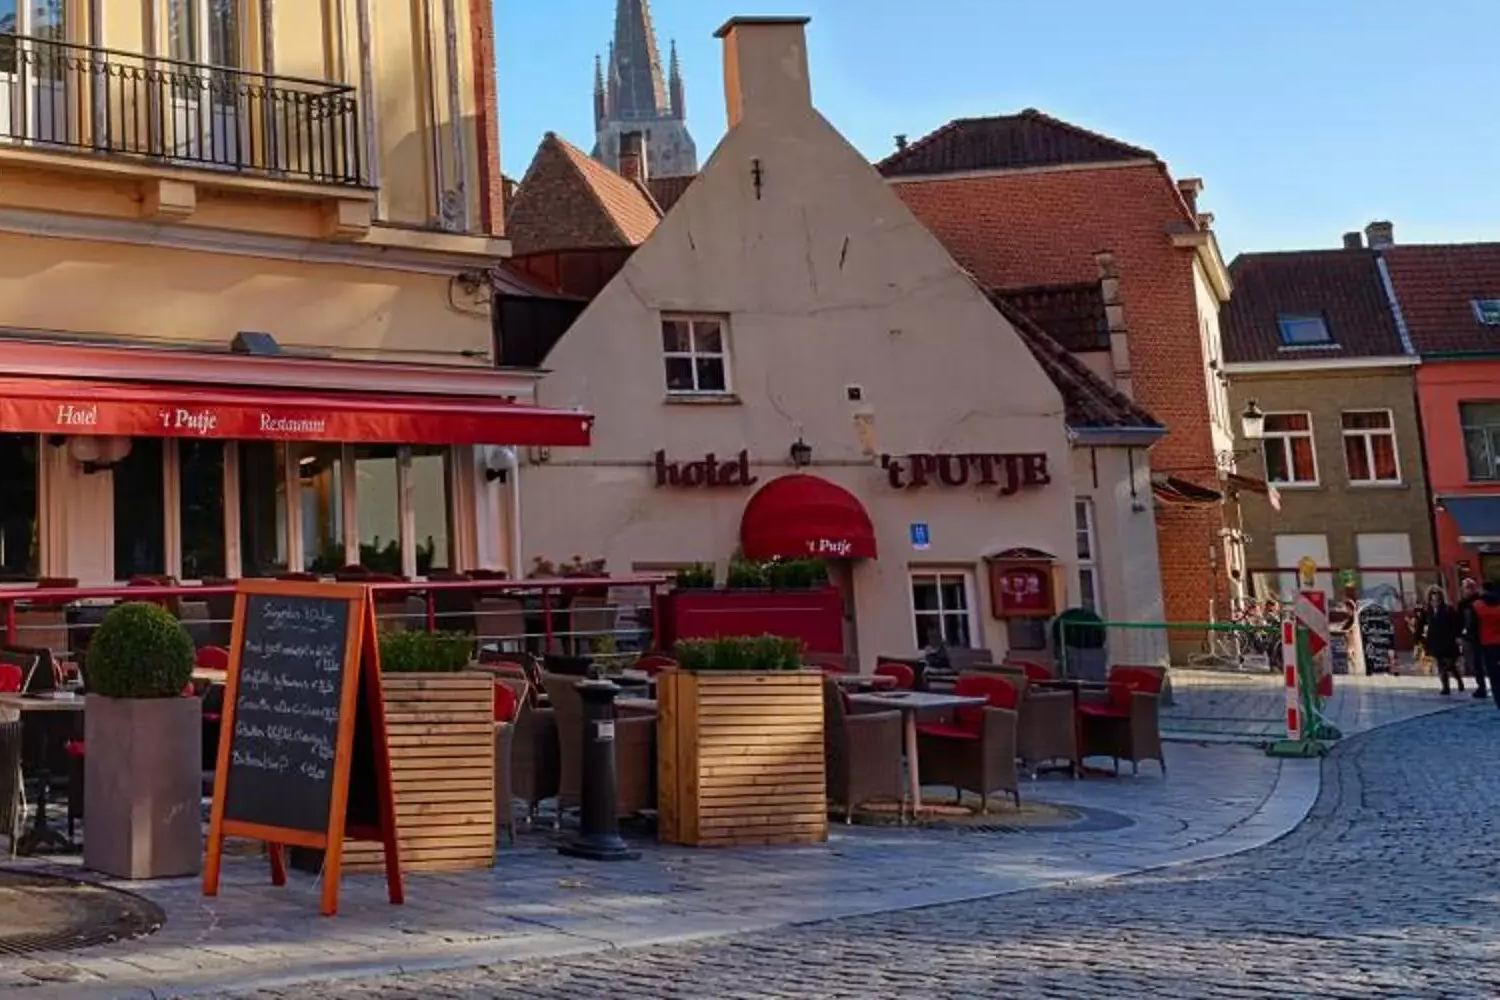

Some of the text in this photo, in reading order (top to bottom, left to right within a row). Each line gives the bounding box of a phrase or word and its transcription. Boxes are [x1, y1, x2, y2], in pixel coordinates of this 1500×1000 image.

[56, 405, 98, 426] Hotel
[174, 409, 217, 434] Putje
[260, 412, 325, 433] Restaurant
[655, 448, 759, 487] hotel
[907, 453, 1051, 496] PUTJE
[819, 538, 852, 555] Putje
